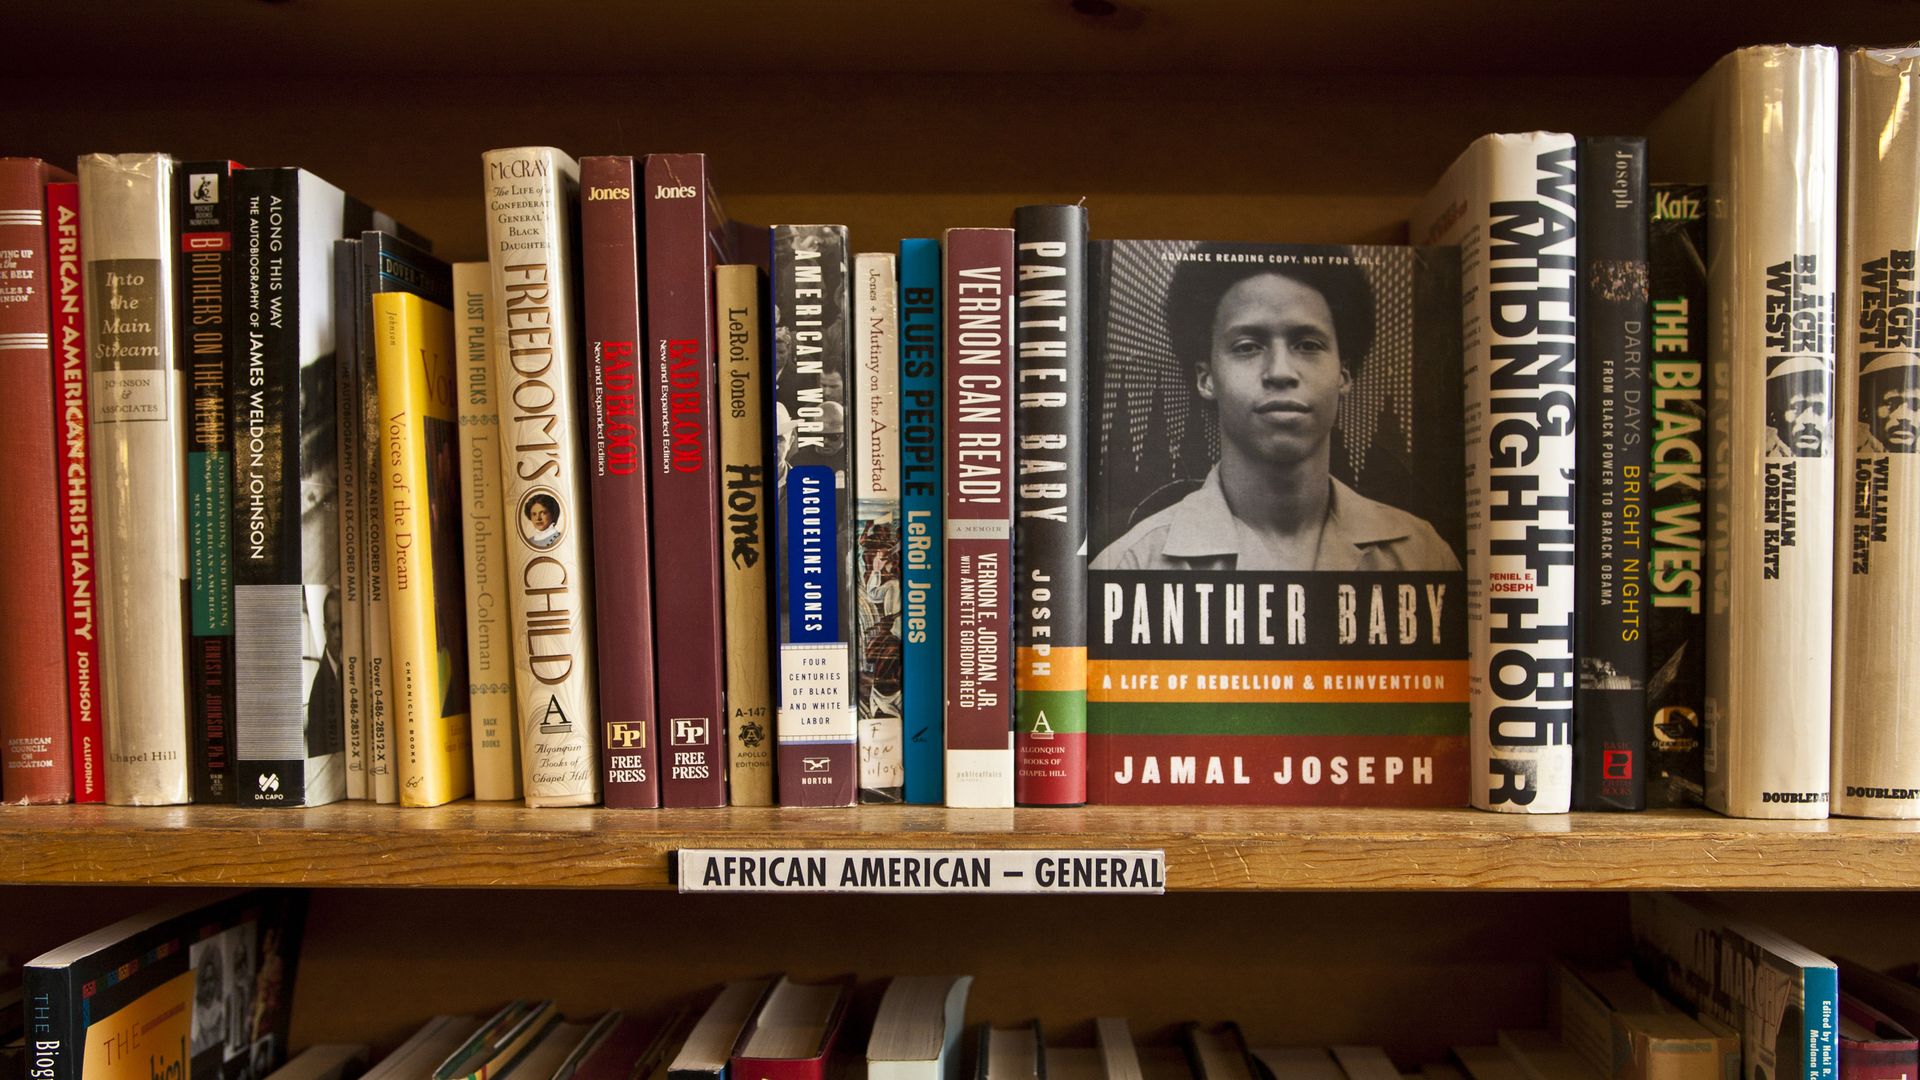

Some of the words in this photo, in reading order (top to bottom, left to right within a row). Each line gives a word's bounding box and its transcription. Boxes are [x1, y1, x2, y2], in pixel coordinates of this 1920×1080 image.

[490, 160, 550, 181] McCRAY
[589, 186, 630, 200] Jones
[655, 185, 696, 199] Jones
[1613, 151, 1633, 208] Joseph
[250, 196, 259, 216] THE
[270, 195, 282, 252] ALONG
[1655, 191, 1700, 219] Katz
[509, 227, 539, 236] BLACK
[106, 272, 144, 287] Into
[190, 238, 222, 325] BROTHERS
[250, 219, 259, 308] AUTOBIOGRAPHY
[270, 258, 282, 291] THIS
[1161, 253, 1211, 262] ADVANCE
[1216, 254, 1263, 263] READING
[1269, 254, 1299, 264] COPY.
[1304, 256, 1324, 265] NOT
[1329, 256, 1349, 265] FOR
[111, 296, 138, 309] the
[467, 292, 484, 322] JUST
[870, 268, 880, 303] Jones
[1536, 146, 1576, 436] WAITING
[1765, 261, 1792, 352] WEST
[1793, 254, 1816, 352] BLACK
[1859, 257, 1887, 348] WEST
[1888, 250, 1915, 349] BLACK
[57, 205, 86, 458] AFRICAN-AMERICAN
[102, 319, 151, 334] Main
[250, 311, 259, 328] OF
[270, 297, 282, 328] WAY
[729, 307, 748, 364] LeRoi
[795, 249, 823, 374] AMERICAN
[905, 288, 934, 378] BLUES
[959, 266, 1001, 364] VERNON
[1020, 241, 1067, 408] PANTHER
[1653, 297, 1690, 353] THE
[95, 344, 160, 359] Stream
[193, 333, 222, 354] ON
[250, 332, 264, 386] JAMES
[468, 327, 485, 362] PLAIN
[670, 340, 699, 389] BAD
[865, 317, 884, 373] Mutiny
[1624, 321, 1641, 379] DARK
[195, 361, 224, 389] THE
[470, 367, 487, 405] FOLKS
[504, 263, 560, 481] FREEDOM'S
[731, 367, 749, 419] Jones
[1490, 201, 1540, 568] MIDNIGHT
[1603, 361, 1613, 394] FROM
[195, 397, 224, 444] MEND
[661, 386, 669, 438] Expanded
[797, 388, 824, 448] WORK
[871, 394, 883, 416] the
[959, 375, 1001, 422] CAN
[1603, 399, 1613, 438] BLACK
[1624, 391, 1640, 451] DAYS,
[250, 391, 264, 467] WELDON
[389, 412, 405, 466] Voices
[671, 392, 702, 473] BLOOD
[905, 391, 934, 496] PEOPLE
[1653, 362, 1701, 490] BLACK
[471, 436, 487, 509] Lorraine
[871, 418, 887, 492] Amistad
[959, 433, 1001, 503] READ!
[1020, 434, 1067, 523] BABY
[1602, 443, 1613, 485] POWER
[393, 474, 411, 493] of
[1602, 492, 1613, 506] TO
[1624, 465, 1640, 549] BRIGHT
[1764, 463, 1780, 524] LOREN
[1781, 461, 1796, 547] WILLIAM
[250, 472, 264, 558] JOHNSON
[394, 499, 411, 529] the
[726, 464, 764, 571] Home
[802, 477, 821, 574] JACQUELINE
[1602, 512, 1613, 559] BARACK
[67, 463, 92, 641] CHRISTIANITY
[396, 533, 413, 590] Dream
[908, 510, 931, 570] LeRoi
[960, 556, 970, 574] WITH
[1653, 503, 1701, 614] WEST
[1764, 530, 1779, 580] KATZ
[471, 513, 495, 671] Johnson-Coleman
[804, 581, 822, 632] JONES
[960, 578, 975, 625] ANNETTE
[978, 553, 997, 610] VERNON
[1490, 584, 1533, 592] JOSEPH
[1602, 566, 1613, 605] OBAMA
[1623, 559, 1639, 642] NIGHTS
[524, 556, 573, 685] CHILD
[908, 580, 931, 644] Jones
[977, 612, 997, 622] E.
[1032, 569, 1050, 676] JOSEPH
[1104, 583, 1306, 645] PANTHER
[1338, 584, 1446, 645] BABY
[348, 657, 357, 685] Dover
[789, 673, 841, 681] CENTURIES
[803, 658, 826, 666] FOUR
[960, 629, 975, 708] GORDON-REED
[977, 627, 997, 686] JORDAN,
[1536, 612, 1574, 745] THE
[77, 651, 91, 722] JOHNSON
[405, 661, 414, 723] CHRONICLE
[810, 687, 838, 695] BLACK
[813, 702, 840, 710] WHITE
[977, 690, 997, 711] JR.
[1103, 675, 1112, 689] A
[1121, 675, 1158, 689] LIFE
[1168, 675, 1188, 689] OF
[1197, 675, 1293, 690] REBELLION
[1303, 675, 1315, 689] &
[1324, 675, 1444, 689] REINVENTION
[1489, 598, 1538, 806] HOUR
[349, 688, 361, 757] 0-486-28512-X
[735, 707, 766, 718] A-147
[801, 717, 829, 725] LABOR
[83, 736, 93, 795] CALIFORNIA
[110, 753, 148, 764] Chapel
[152, 751, 177, 761] Hill
[609, 769, 646, 783] PRESS
[611, 756, 642, 768] FREE
[672, 766, 709, 779] PRESS
[675, 752, 705, 765] FREE
[1114, 756, 1250, 784] JAMAL
[1274, 756, 1433, 785] JOSEPH
[703, 857, 826, 887] AFRICAN
[840, 857, 990, 888] AMERICAN
[1035, 857, 1163, 888] GENERAL
[34, 993, 49, 1033] THE
[1821, 1031, 1831, 1042] by
[1823, 1000, 1831, 1028] Edited
[1810, 1029, 1818, 1068] Maulana
[1823, 1045, 1831, 1065] Haki
[1823, 1068, 1831, 1077] R.
